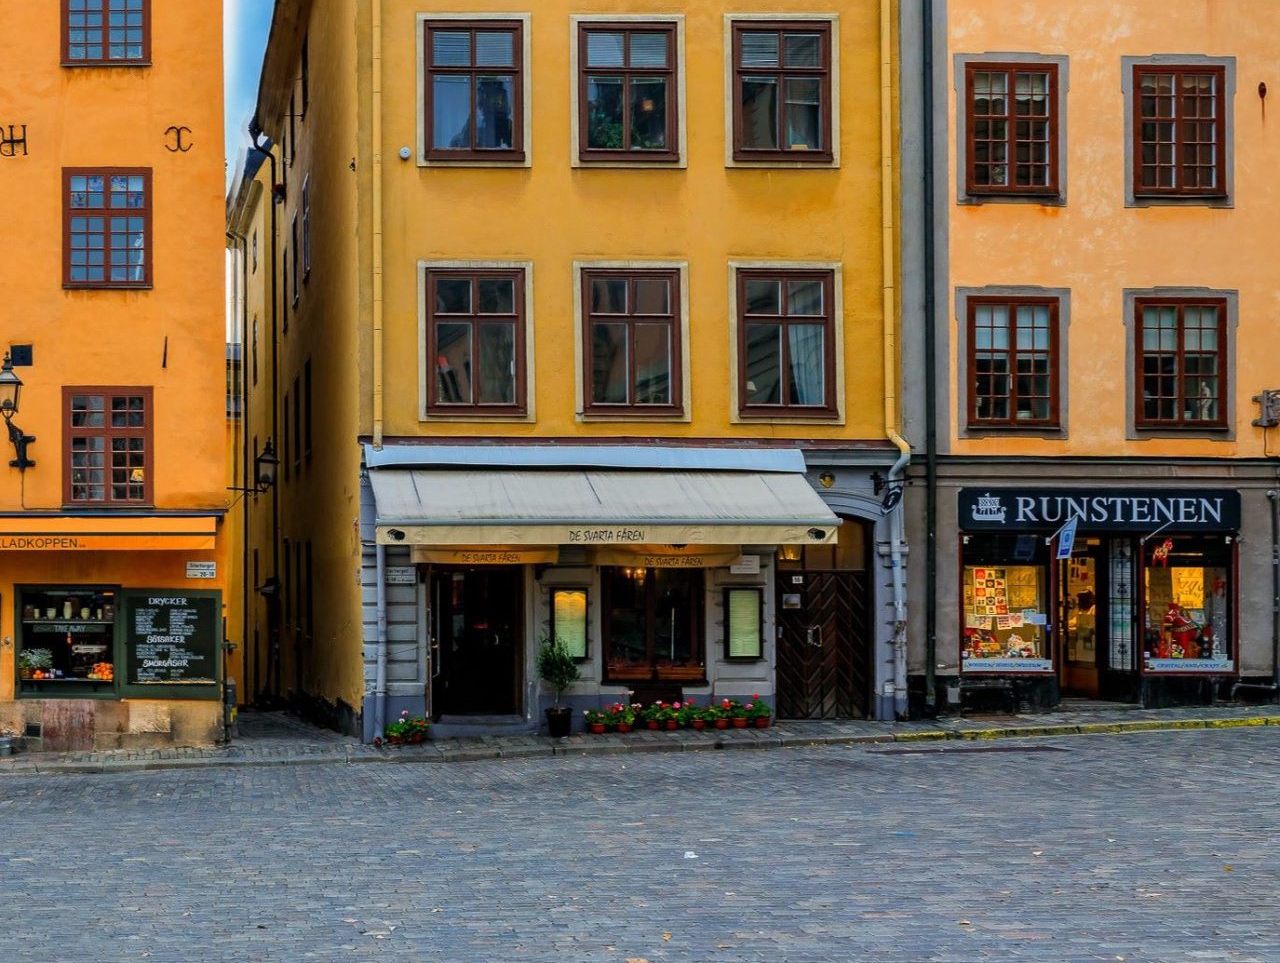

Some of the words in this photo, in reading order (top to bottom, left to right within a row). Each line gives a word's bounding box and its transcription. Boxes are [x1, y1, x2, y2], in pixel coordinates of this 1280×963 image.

[1015, 496, 1224, 523] RUNSTENEN
[569, 530, 581, 541] DE
[583, 530, 613, 541] SVARTA
[616, 528, 645, 541] FÅREN
[148, 597, 187, 606] DRYCKER
[146, 635, 185, 644] SÖTSAKER
[142, 657, 189, 667] SMÖRGÅSAR
